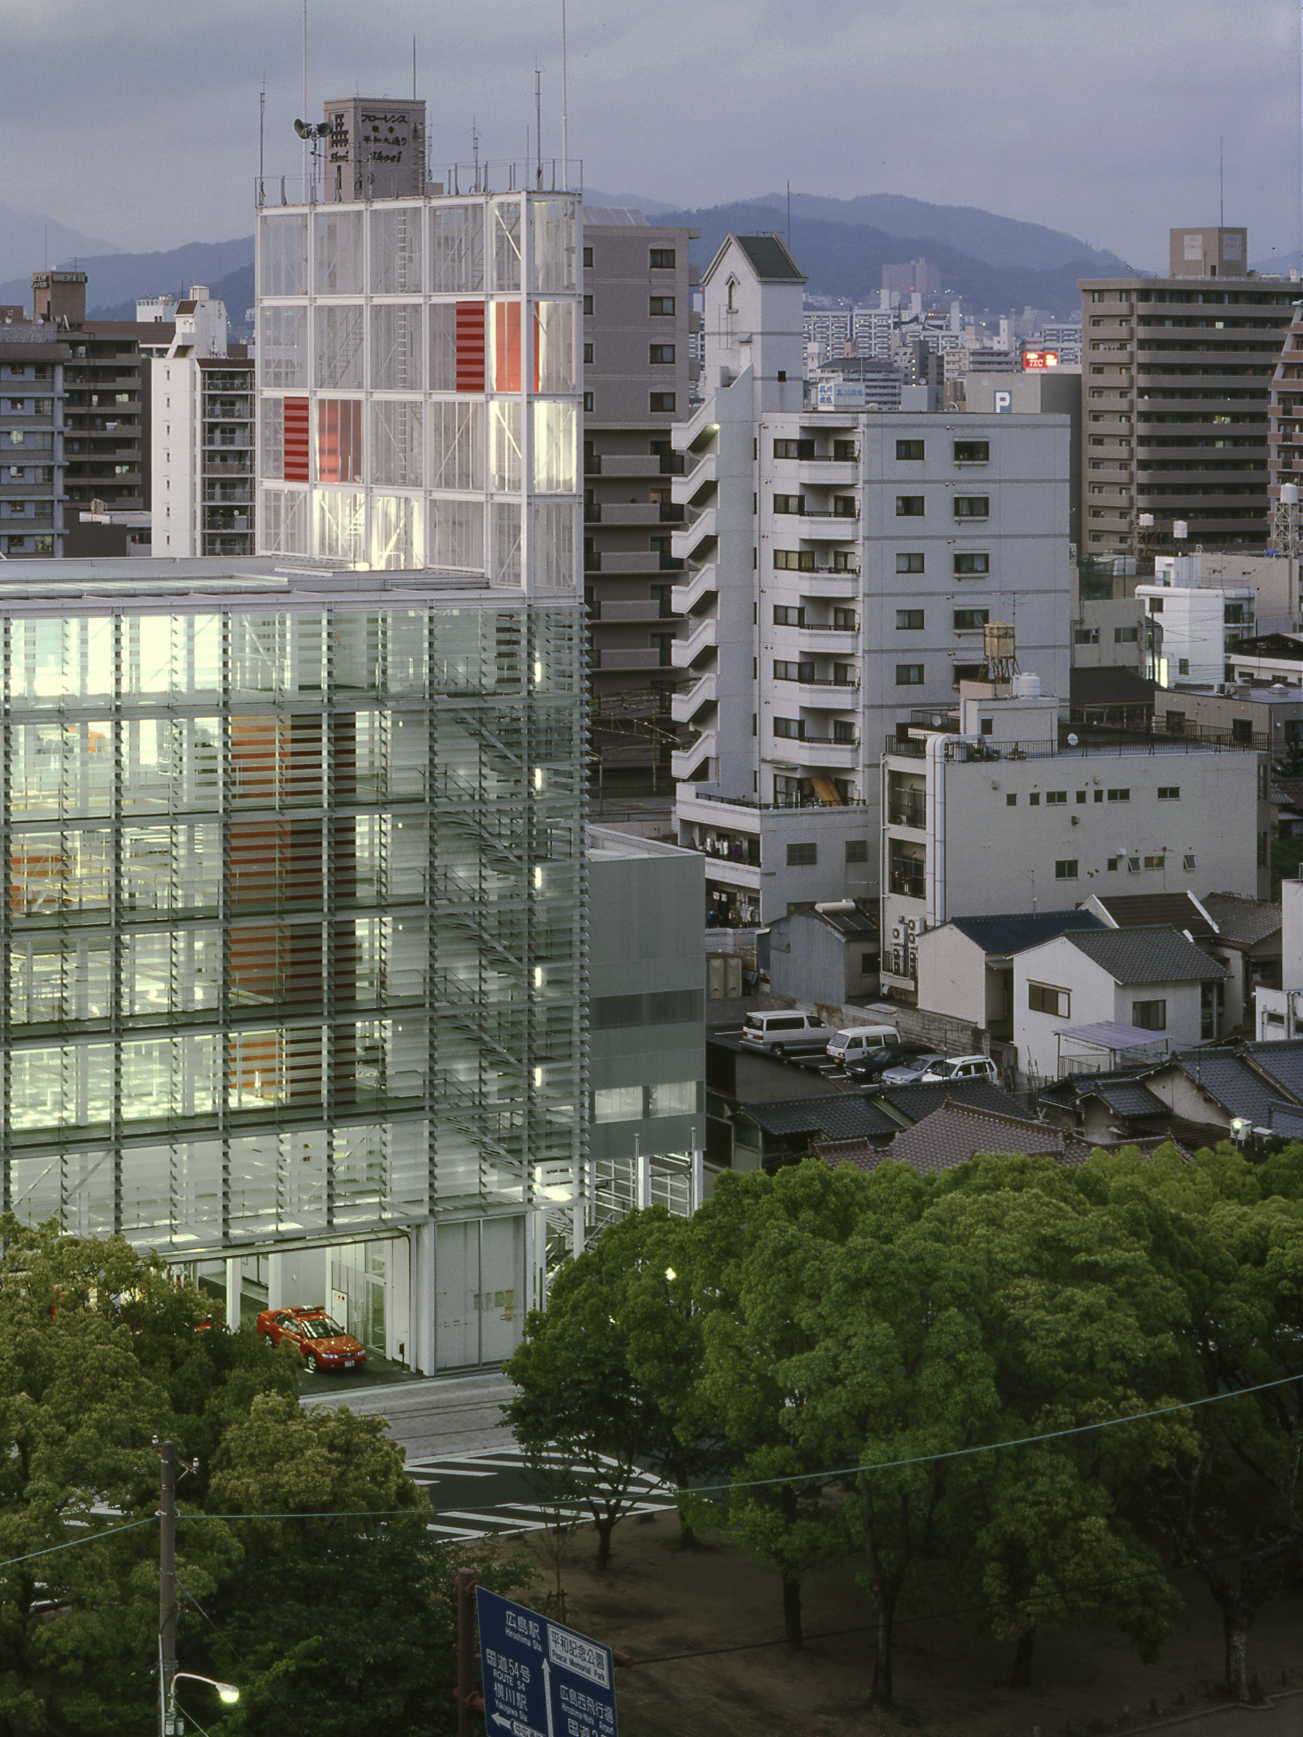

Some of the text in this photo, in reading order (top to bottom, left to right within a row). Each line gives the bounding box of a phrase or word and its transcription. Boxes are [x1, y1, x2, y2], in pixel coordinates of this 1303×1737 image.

[996, 392, 1010, 412] P
[505, 1611, 541, 1640] 広島駅
[505, 1627, 532, 1647] Hiroshima
[552, 1632, 604, 1670] 平和記念公園
[486, 1648, 530, 1684] 国道54号
[493, 1669, 526, 1692] ROUTE 54
[552, 1650, 606, 1682] Peace Memorial Park
[494, 1682, 528, 1712] 横川駅
[494, 1698, 518, 1718] Yokogawa
[560, 1684, 614, 1724] 広島西飛行場
